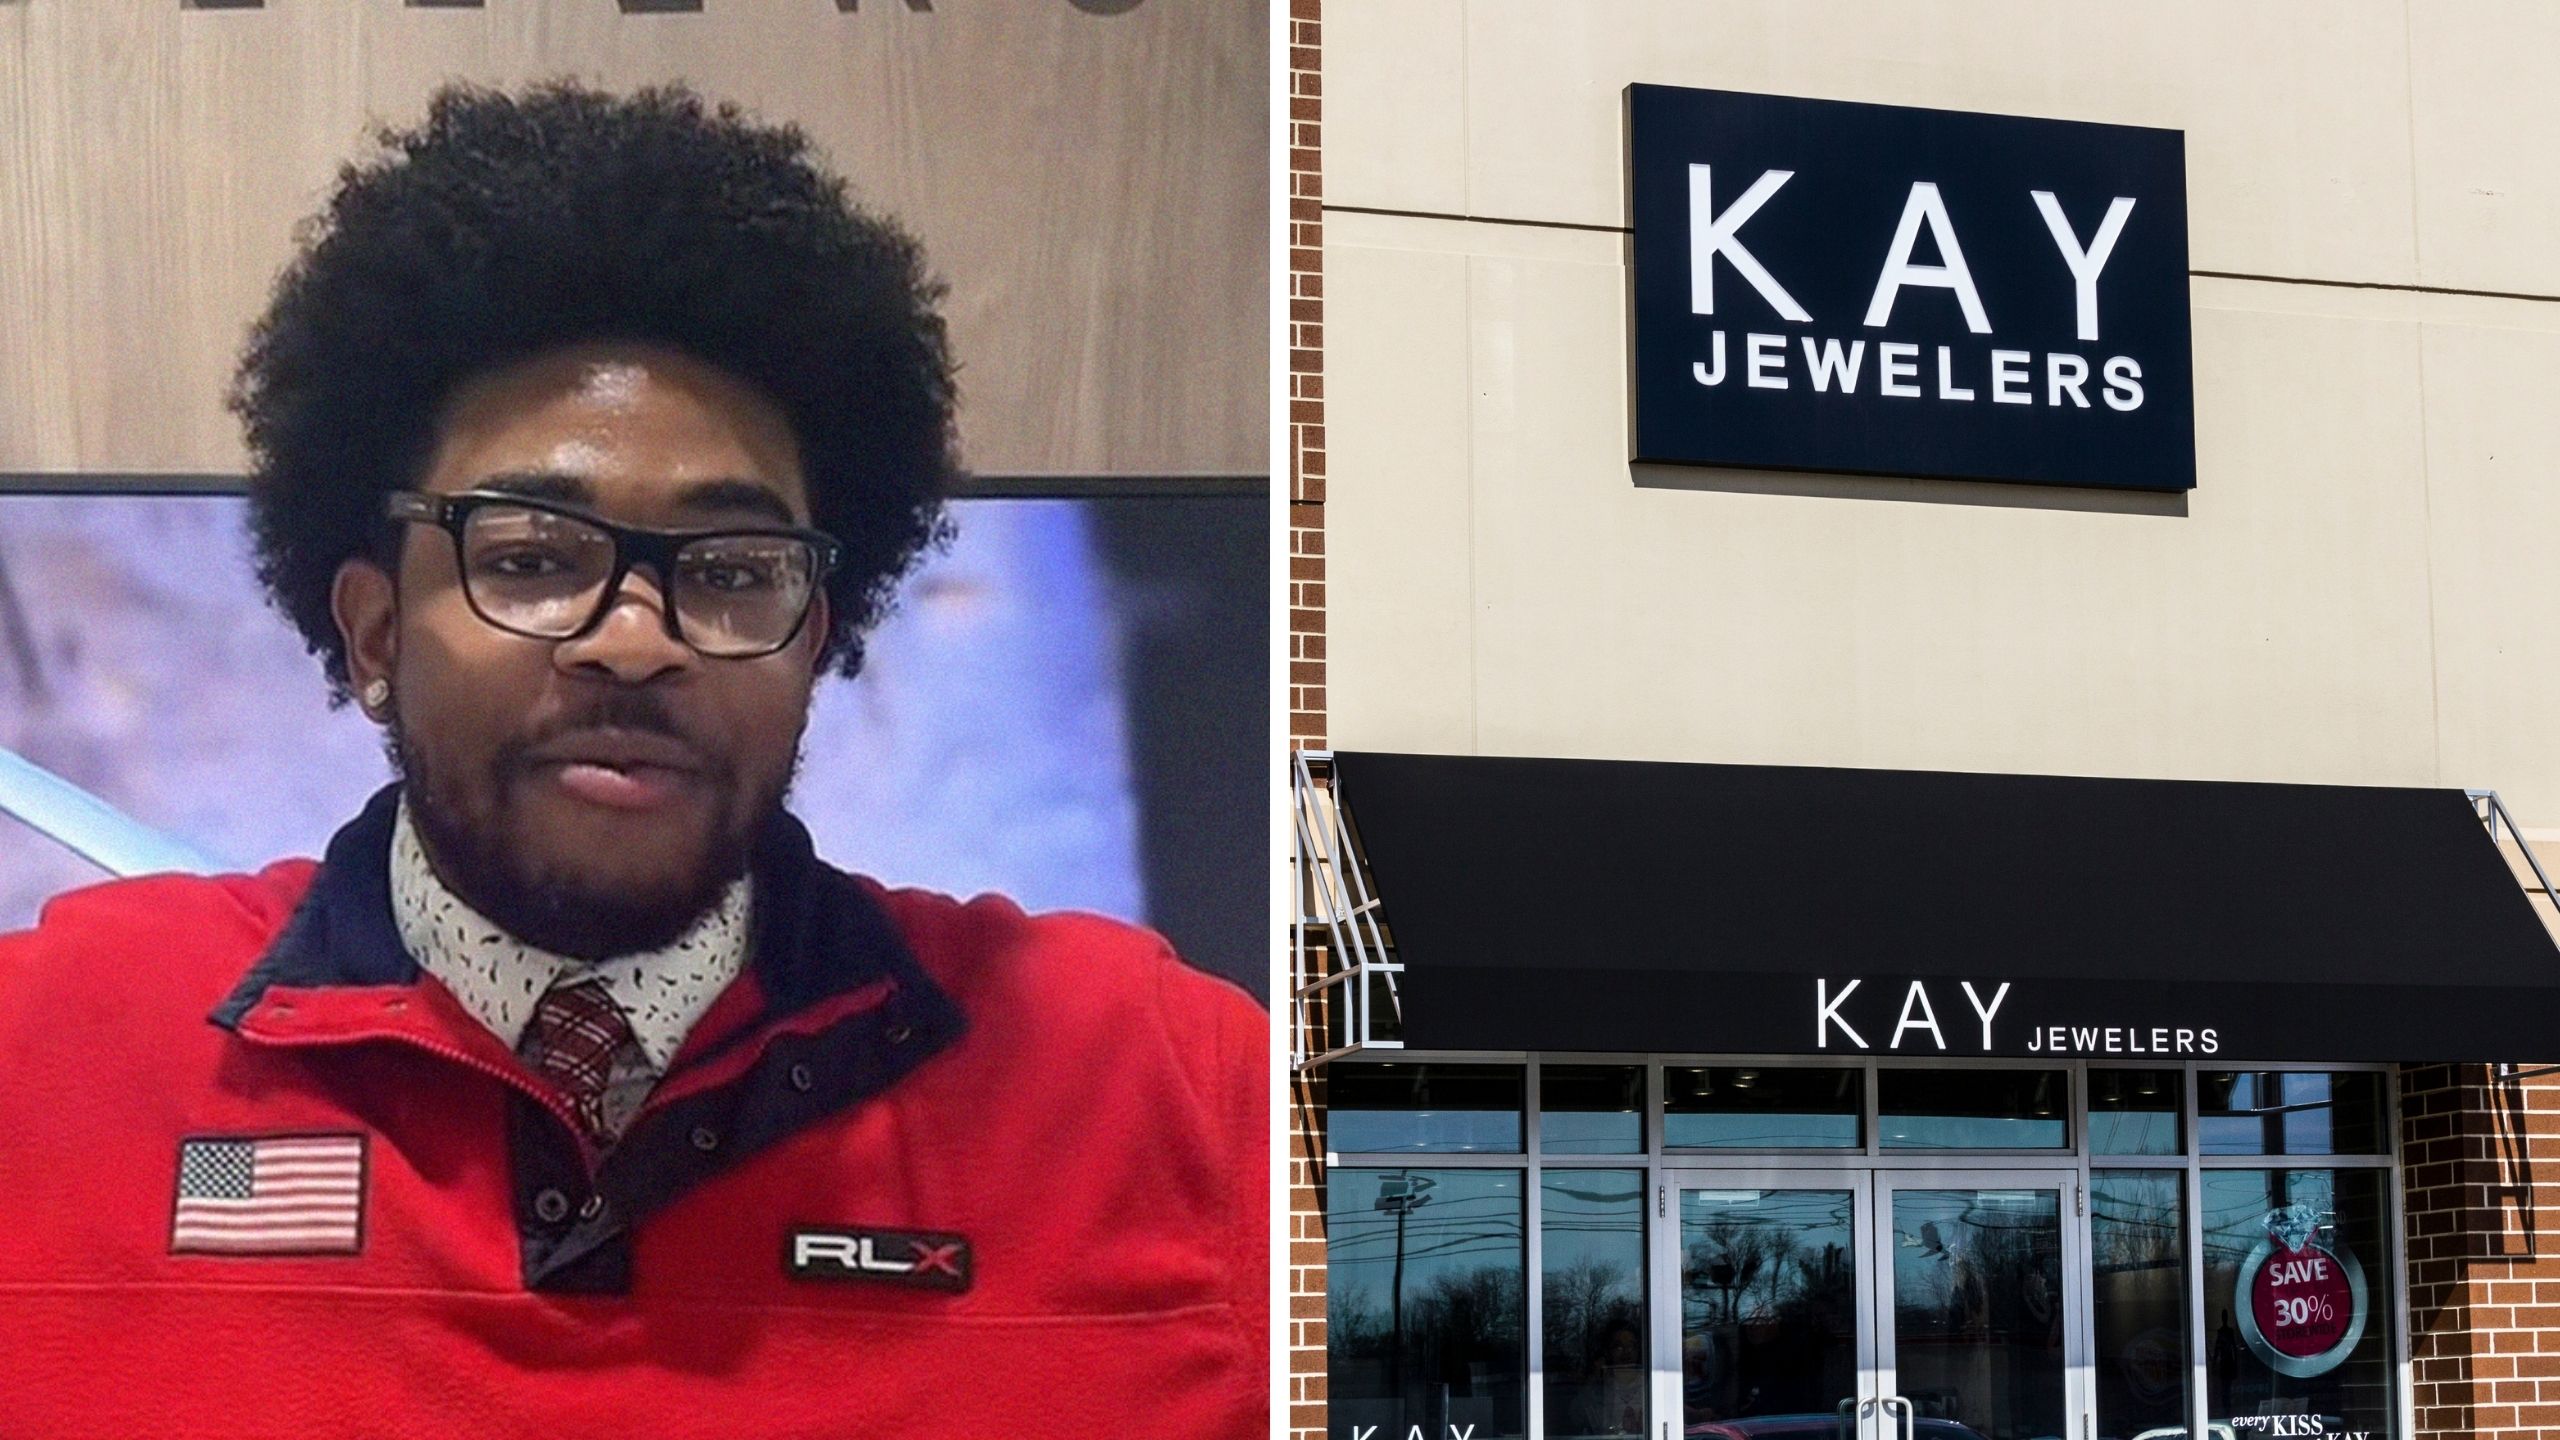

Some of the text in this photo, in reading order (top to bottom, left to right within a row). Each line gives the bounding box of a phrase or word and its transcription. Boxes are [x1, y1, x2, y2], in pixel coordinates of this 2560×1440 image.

[1688, 163, 2137, 341] KAY
[1692, 330, 2145, 412] JEWELERS
[1817, 978, 2219, 1054] KAY JEWELERS
[795, 1234, 963, 1277] RLX
[2269, 1258, 2329, 1287] SAVE
[2274, 1294, 2333, 1327] 30%
[2231, 1416, 2270, 1431] every
[2272, 1414, 2324, 1437] KISS
